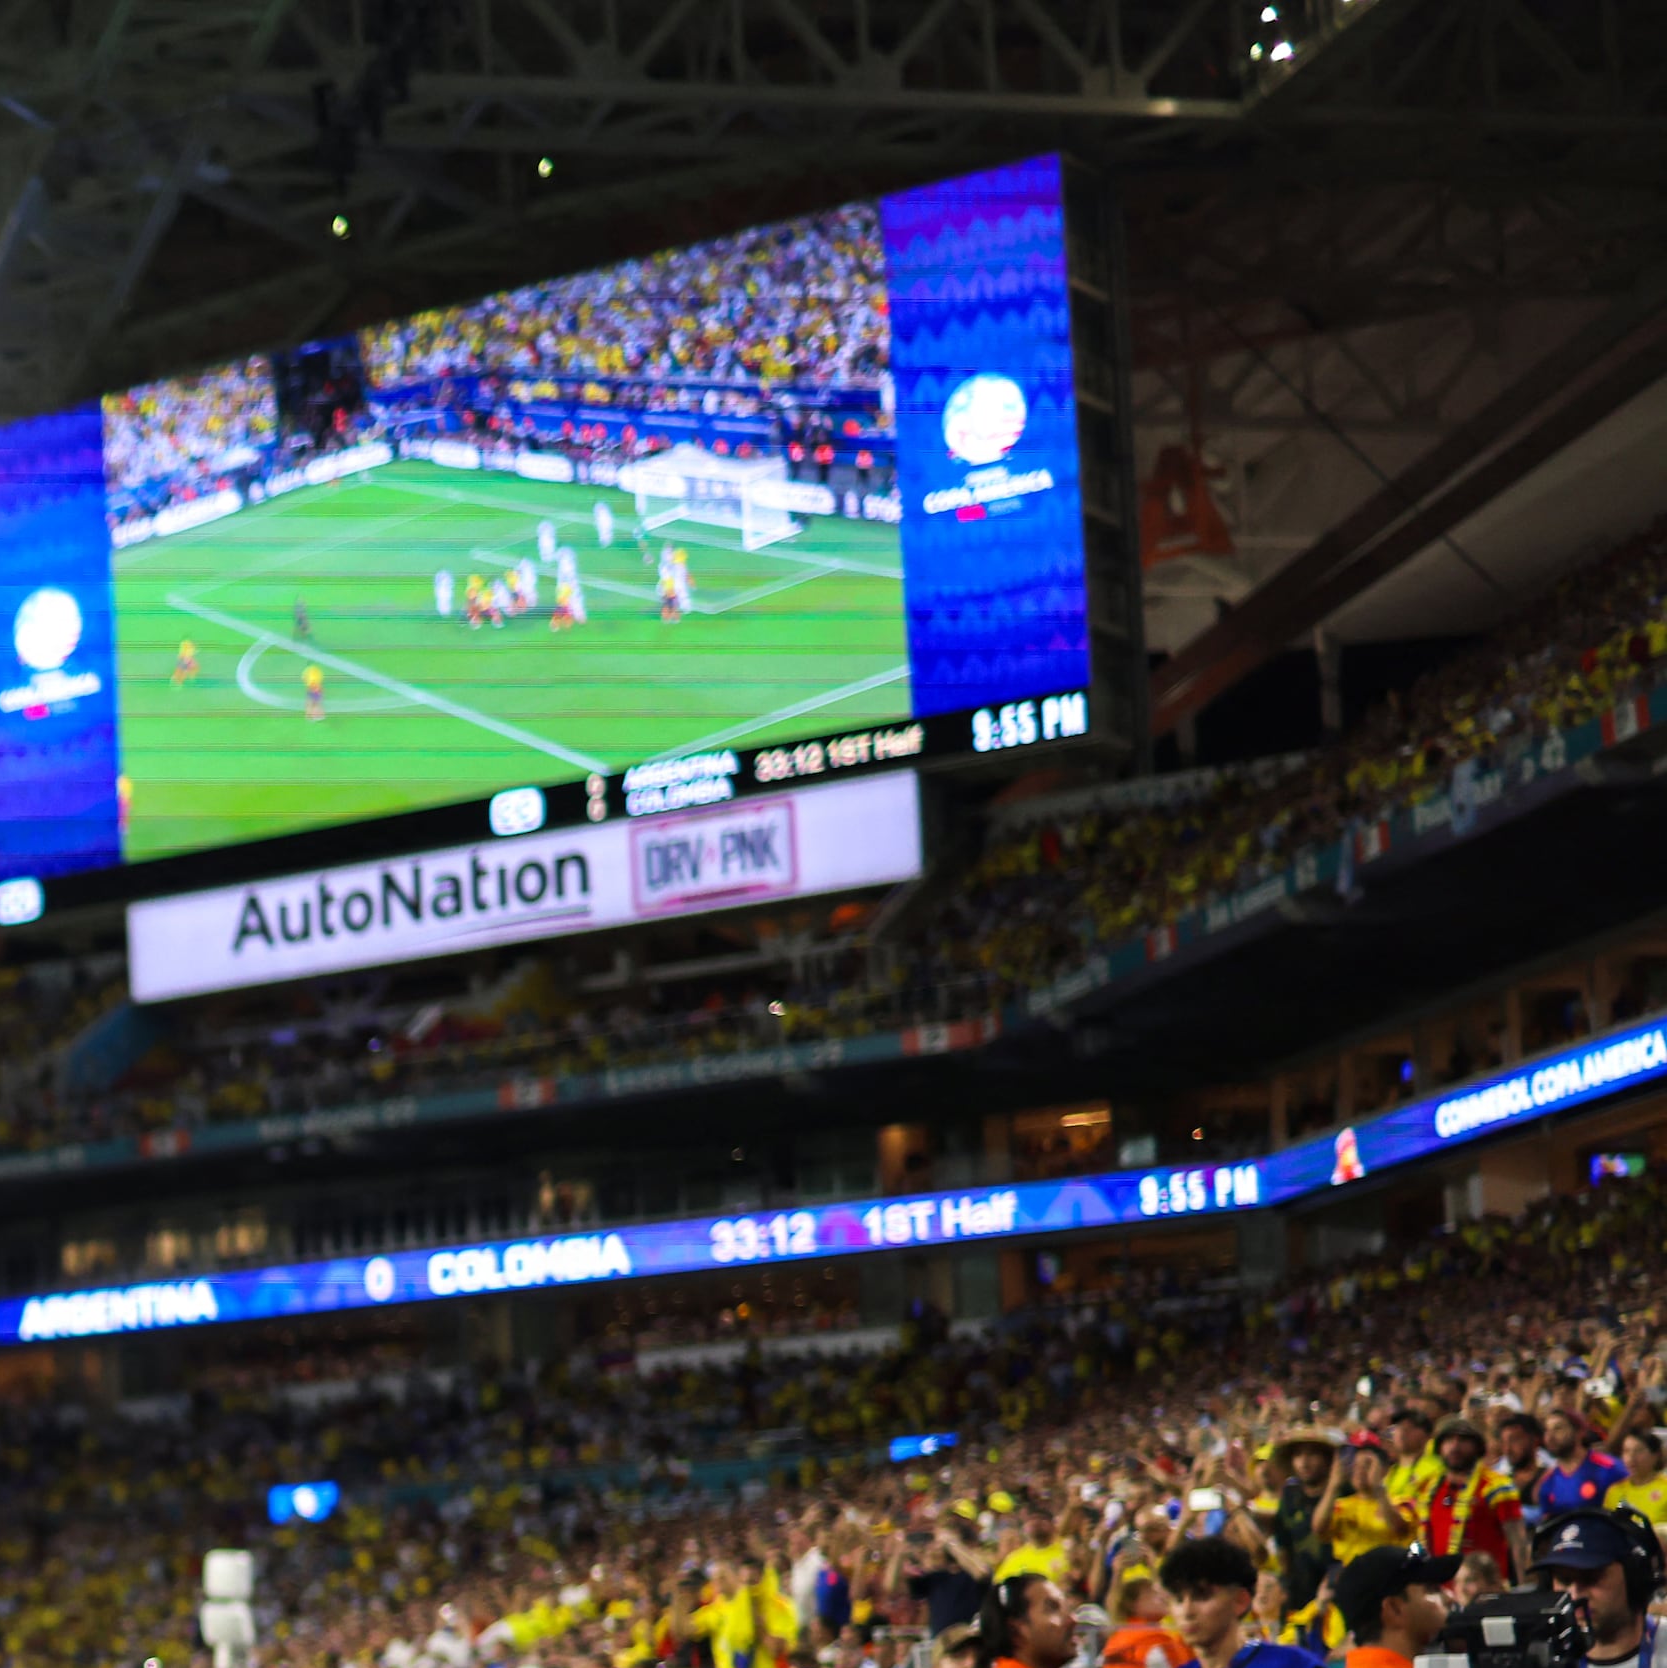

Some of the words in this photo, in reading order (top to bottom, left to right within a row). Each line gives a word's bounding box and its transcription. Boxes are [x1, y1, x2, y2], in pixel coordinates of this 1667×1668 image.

[1043, 694, 1085, 740] PM
[719, 819, 783, 874] PNK
[233, 848, 592, 955] AutoNation
[20, 1281, 218, 1339] ARGENTINA
[364, 1258, 394, 1301] 0
[428, 1234, 631, 1295] COLOMBIA
[711, 1212, 817, 1263] 33:12
[862, 1202, 936, 1246] 1ST
[941, 1191, 1018, 1238] Half
[1215, 1166, 1258, 1206] PM
